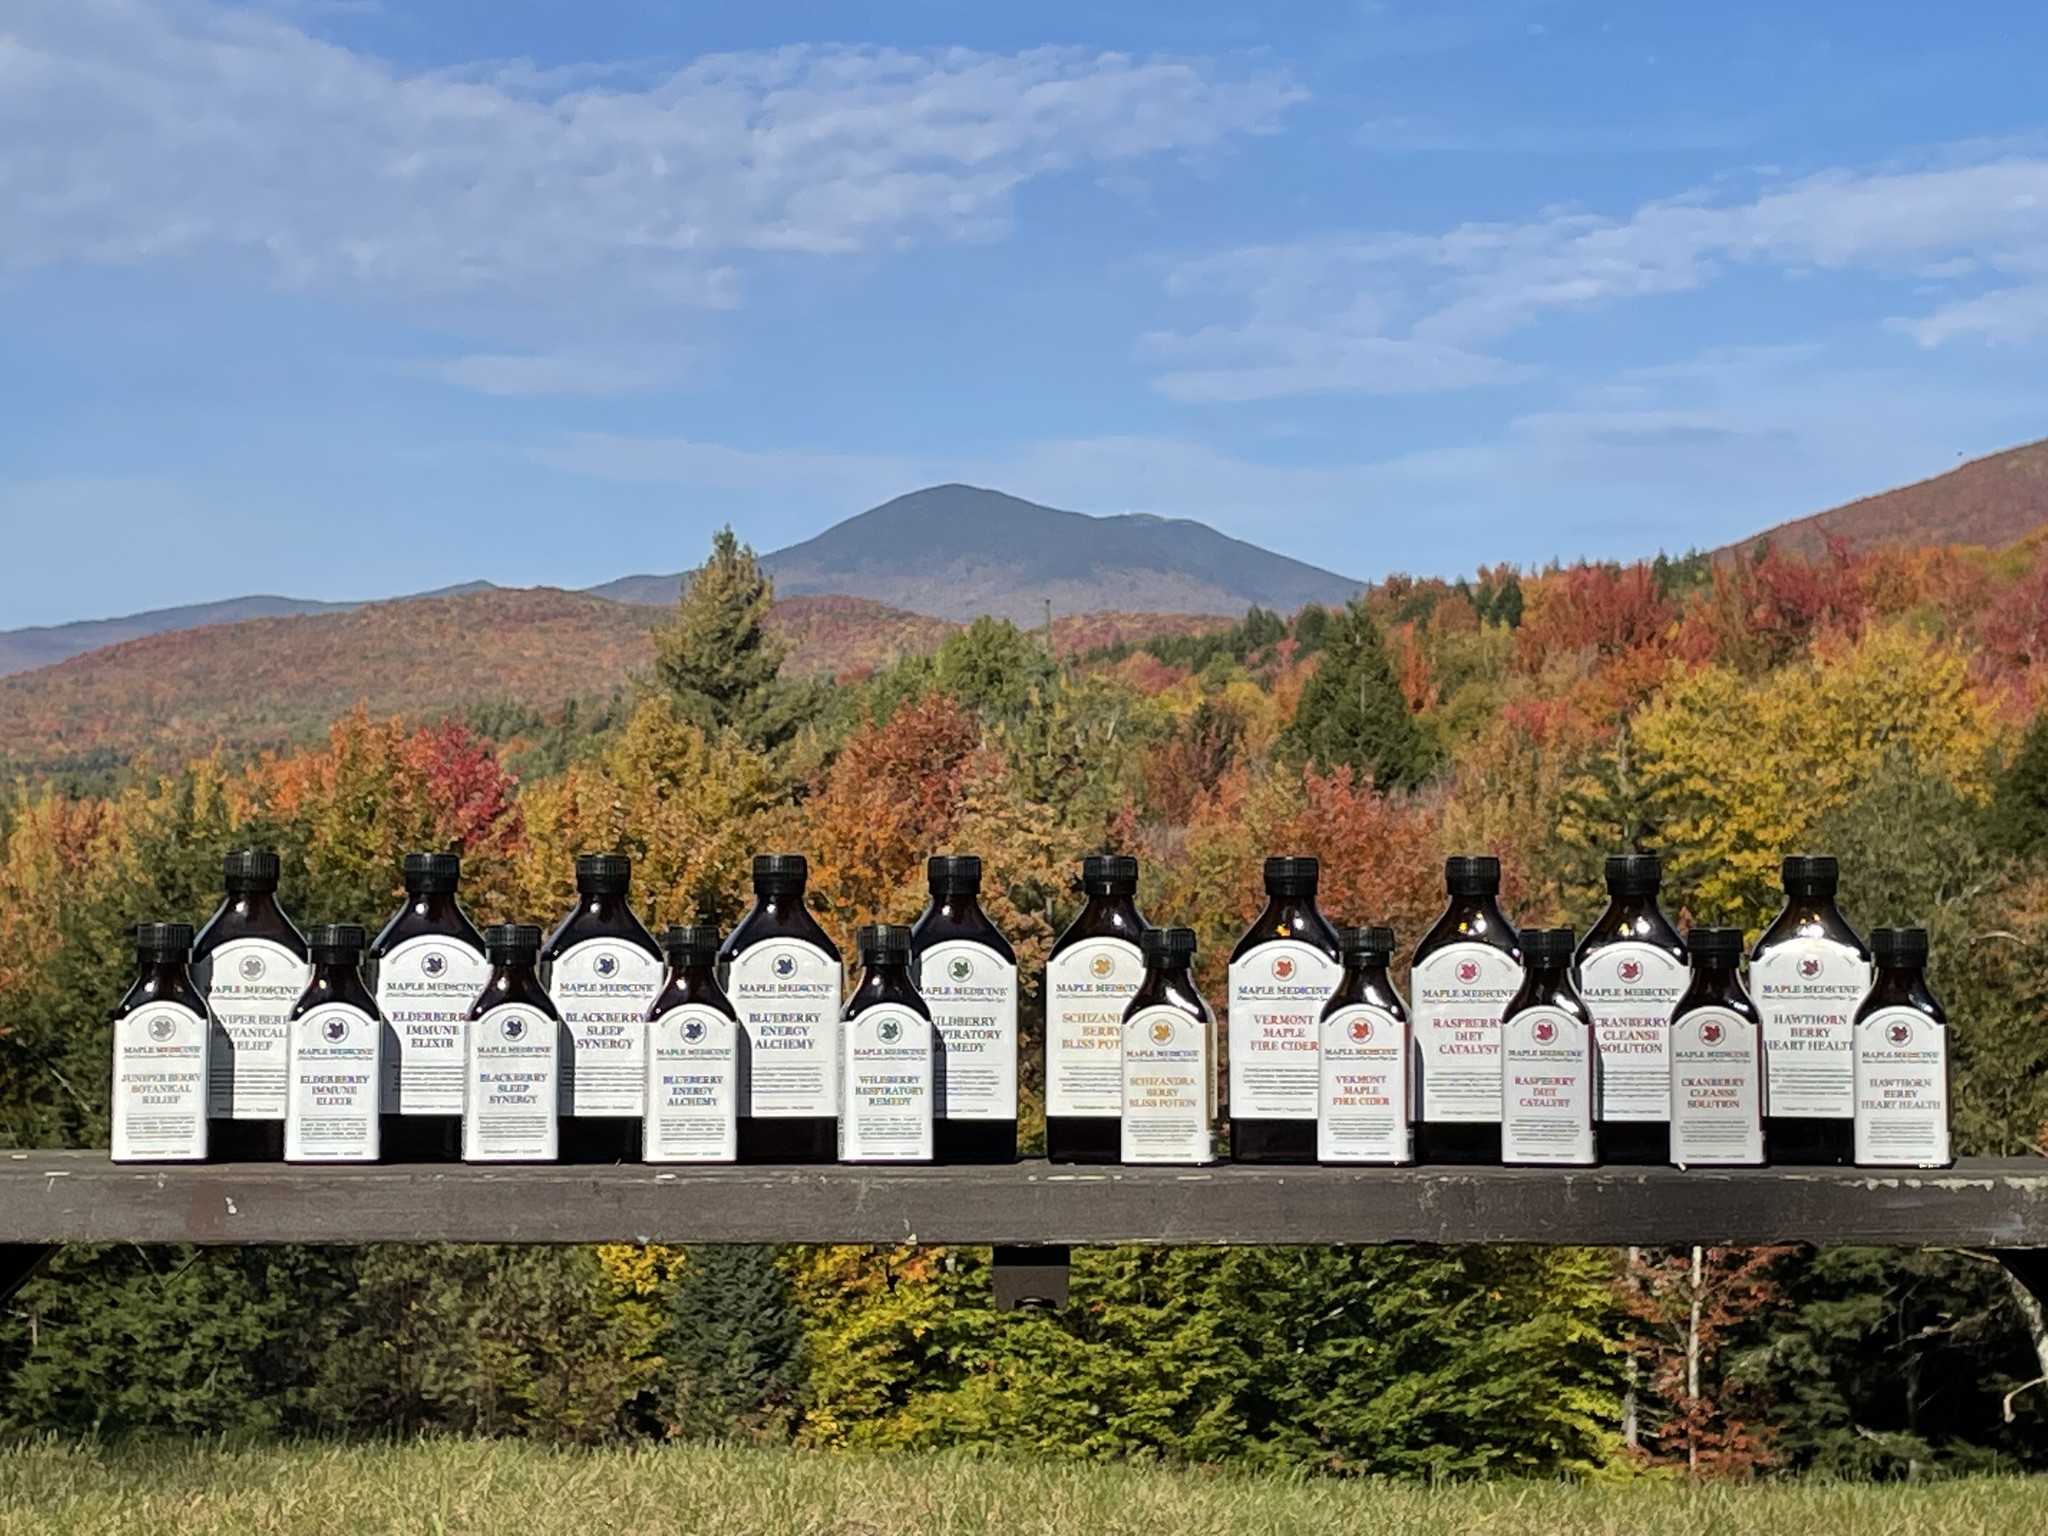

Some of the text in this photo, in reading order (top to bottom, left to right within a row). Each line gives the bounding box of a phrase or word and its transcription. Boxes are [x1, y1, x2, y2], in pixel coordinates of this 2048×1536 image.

[244, 985, 300, 994] MEDICINE
[387, 982, 483, 991] MAPLE MEDICINE
[560, 983, 654, 992] MAPLE MEDICINE
[738, 983, 833, 993] MAPLE MEDICINE
[954, 986, 1008, 995] MEDICINE
[1056, 983, 1140, 992] MAPLE MEDICIN
[1238, 985, 1331, 994] MAPLE MEDICINE
[1763, 985, 1860, 994] MAPLE MEDICINE
[1422, 989, 1459, 998] MAPLE
[1584, 987, 1679, 996] MAPLE MEDICINE
[219, 1015, 256, 1025] NIPER
[749, 1013, 820, 1024] BLUEBERRY
[932, 1016, 997, 1026] ILDBERRY
[1254, 1015, 1313, 1025] VERMONT
[1594, 1017, 1670, 1027] CRANBERRY
[1773, 1014, 1847, 1025] HAWTHORN
[406, 1025, 459, 1035] IMMUNE
[586, 1026, 625, 1036] SLEEP
[761, 1026, 809, 1036] ENERGY
[1263, 1028, 1305, 1038] MAPLE
[1790, 1027, 1830, 1038] BERRY
[1455, 1031, 1484, 1041] DIET
[1603, 1030, 1659, 1041] CLEANSE
[411, 1038, 453, 1048] ELIXIR
[576, 1038, 634, 1050] SYNERGY
[754, 1039, 815, 1050] ALCHEMY
[1062, 1038, 1121, 1050] BLISS POT
[1250, 1040, 1318, 1051] FIRE CIDER
[1439, 1044, 1499, 1054] CATALYST
[1601, 1043, 1663, 1053] SOLUTION
[122, 1074, 201, 1083] JUNIPER BERRY
[300, 1075, 369, 1084] ELDERBERRY
[481, 1073, 547, 1083] BLACKBERRY
[663, 1075, 723, 1085] BLUEBERRY
[859, 1075, 920, 1085] WILDBERRY
[1129, 1077, 1195, 1086] SCHIZANDRA
[1335, 1075, 1386, 1084] VERMONT
[1515, 1077, 1576, 1086] RASPBERRY
[1682, 1078, 1745, 1087] CRANBERRY
[1869, 1078, 1932, 1087] HAWTHORN
[131, 1085, 192, 1094] BOTANICAL
[312, 1086, 357, 1095] IMMUNE
[498, 1085, 529, 1093] SLEEP
[672, 1087, 714, 1095] ENERGY
[855, 1086, 924, 1096] RESPIRATORY
[1147, 1088, 1178, 1096] BERRY
[1344, 1086, 1379, 1095] MAPLE
[1533, 1088, 1557, 1096] DIET
[1690, 1089, 1737, 1097] CLEANSE
[1884, 1089, 1918, 1098] BERRY
[142, 1096, 180, 1104] RELIEF
[316, 1097, 352, 1105] ELIXIR
[489, 1095, 537, 1104] SYNERGY
[668, 1097, 717, 1106] ALCHEMY
[869, 1097, 912, 1106] REMEDY
[1129, 1098, 1197, 1108] BLISS POTION
[1333, 1097, 1390, 1105] FIRE CIDER
[1520, 1098, 1571, 1108] CATALYST
[1687, 1100, 1740, 1109] SOLUTION
[1861, 1100, 1941, 1109] HEART HEALTH
